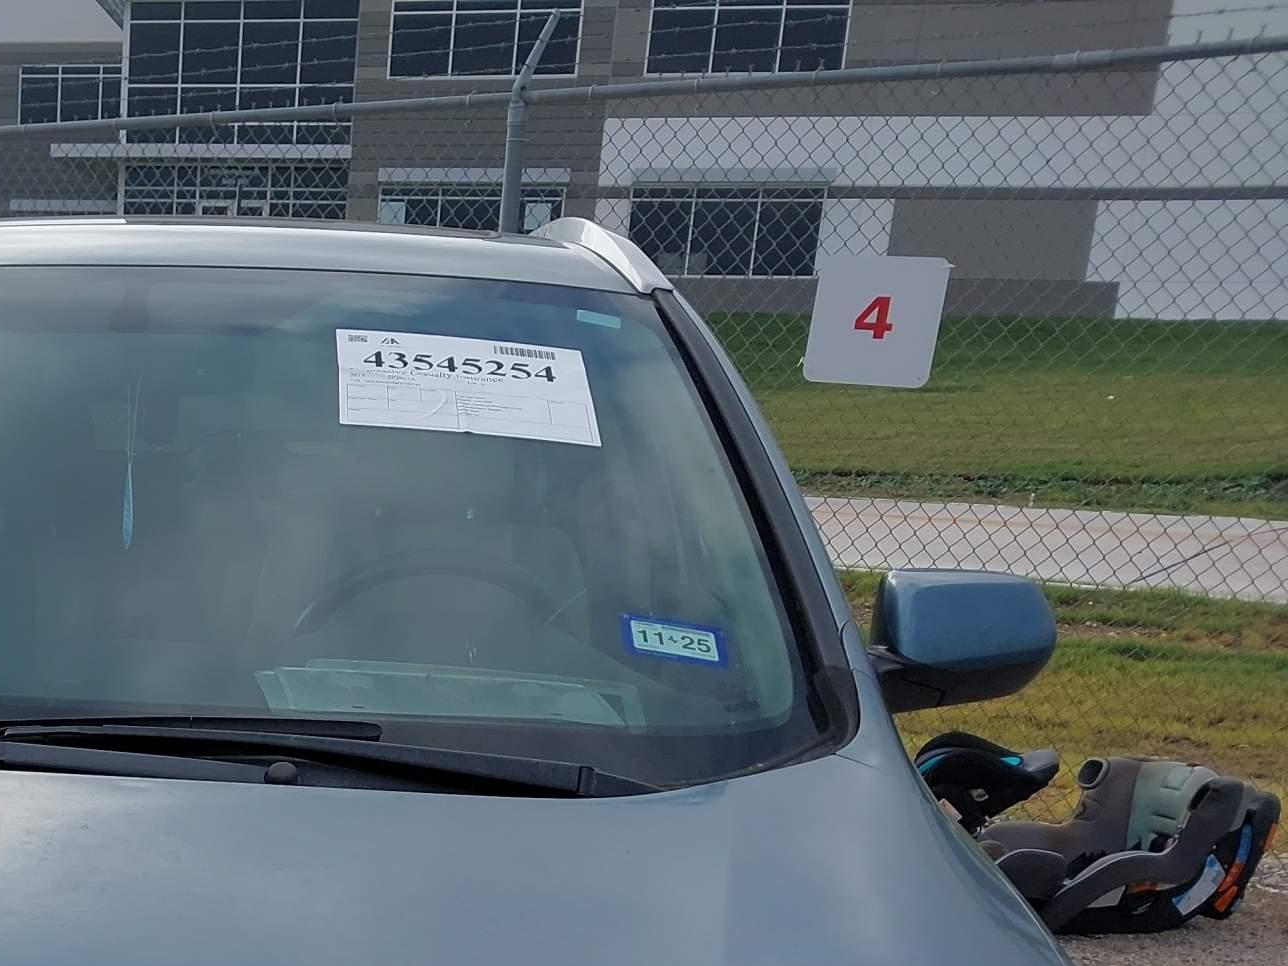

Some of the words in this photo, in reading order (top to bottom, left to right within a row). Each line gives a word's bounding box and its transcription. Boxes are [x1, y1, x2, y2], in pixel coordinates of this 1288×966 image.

[854, 295, 894, 340] 4
[363, 349, 557, 383] 43545254
[637, 629, 665, 646] 11
[680, 635, 712, 653] 25
